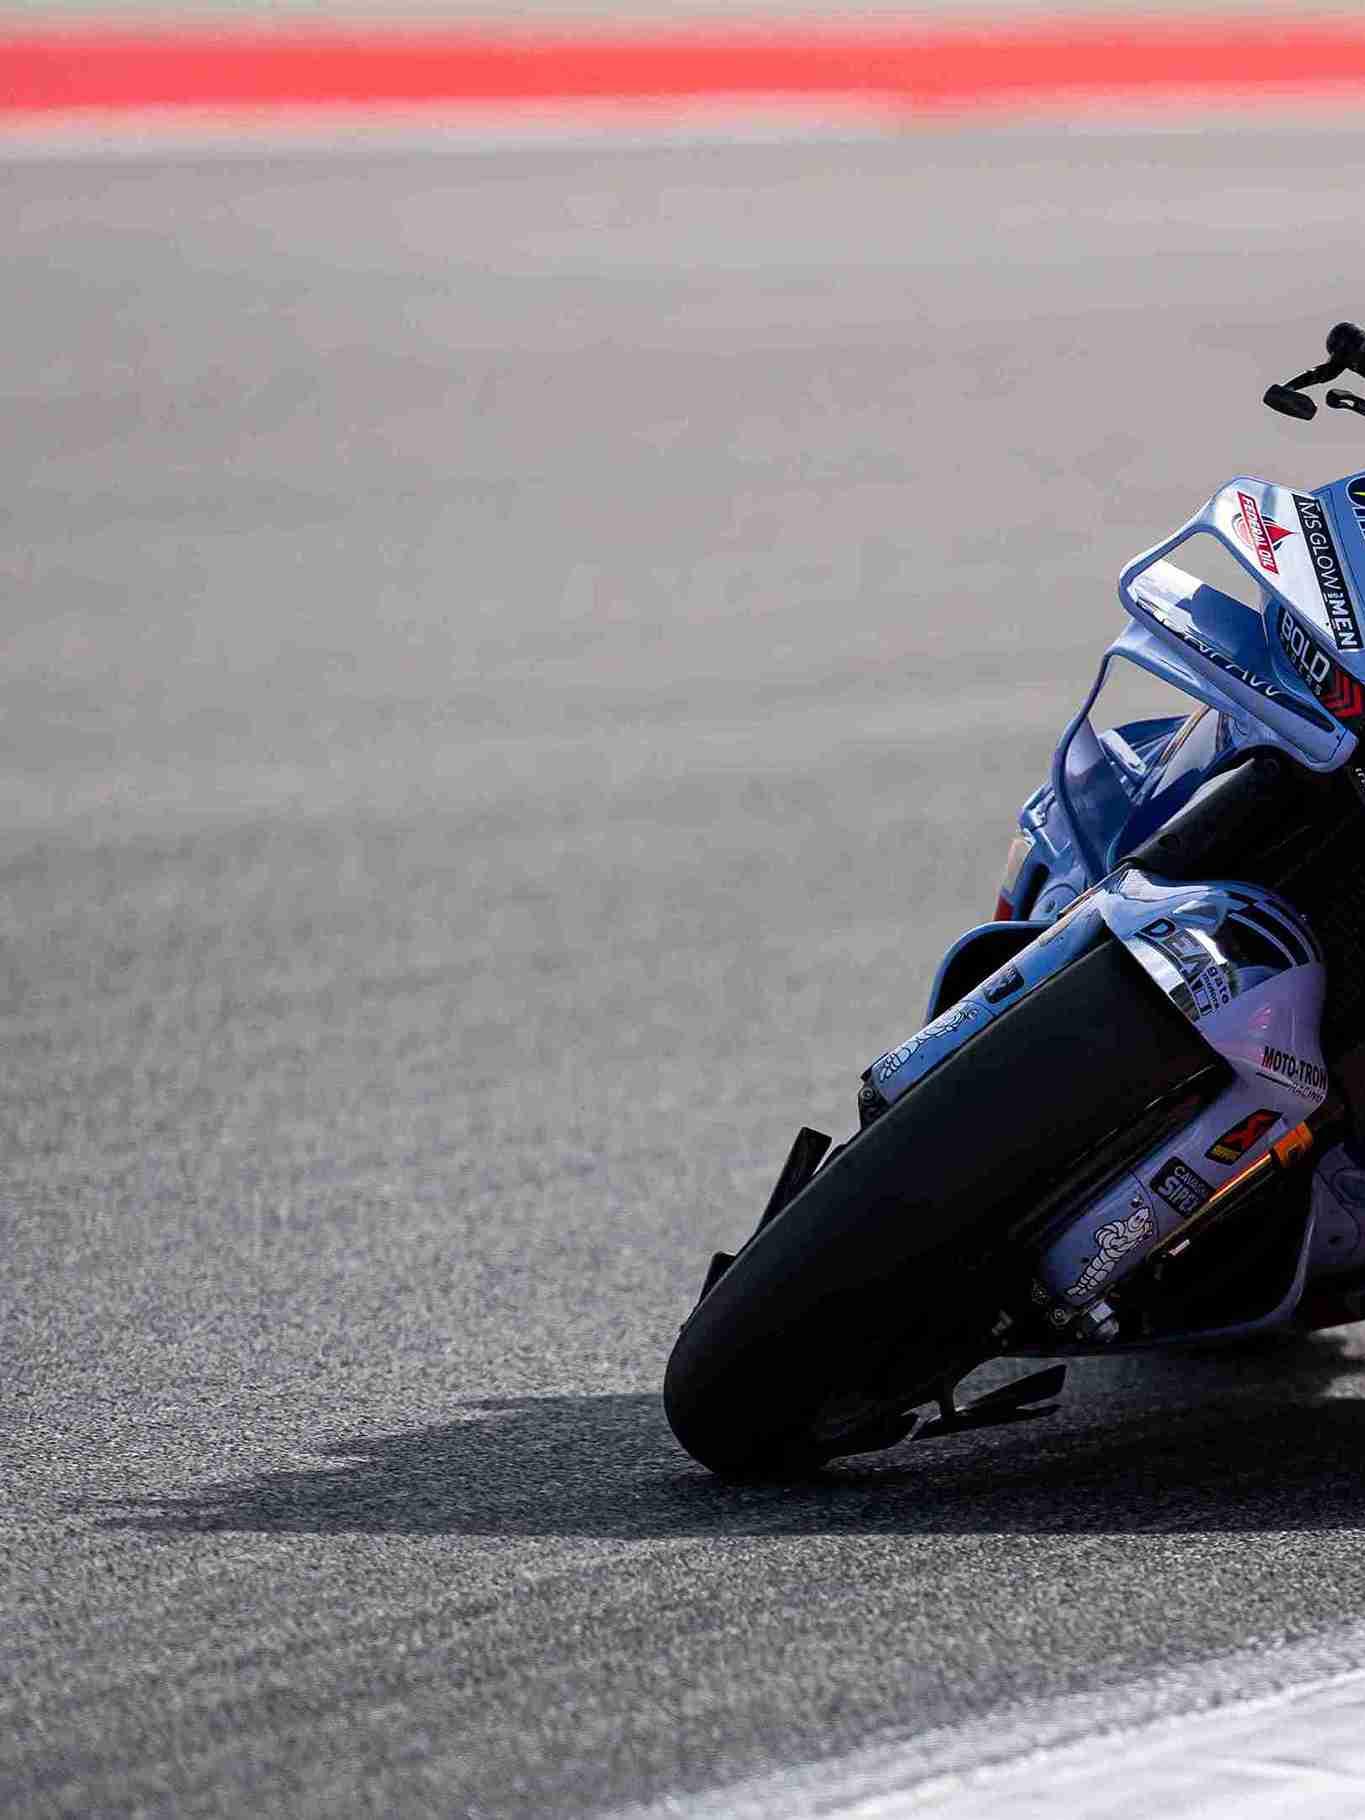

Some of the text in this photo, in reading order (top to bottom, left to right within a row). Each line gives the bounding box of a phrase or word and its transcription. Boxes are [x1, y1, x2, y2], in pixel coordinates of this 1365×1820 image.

[1243, 498, 1276, 573] FEDERAL OIL
[1298, 501, 1322, 529] MS
[1309, 532, 1342, 592] GLOW
[1281, 611, 1331, 683] BOLD
[1330, 599, 1359, 647] MEN
